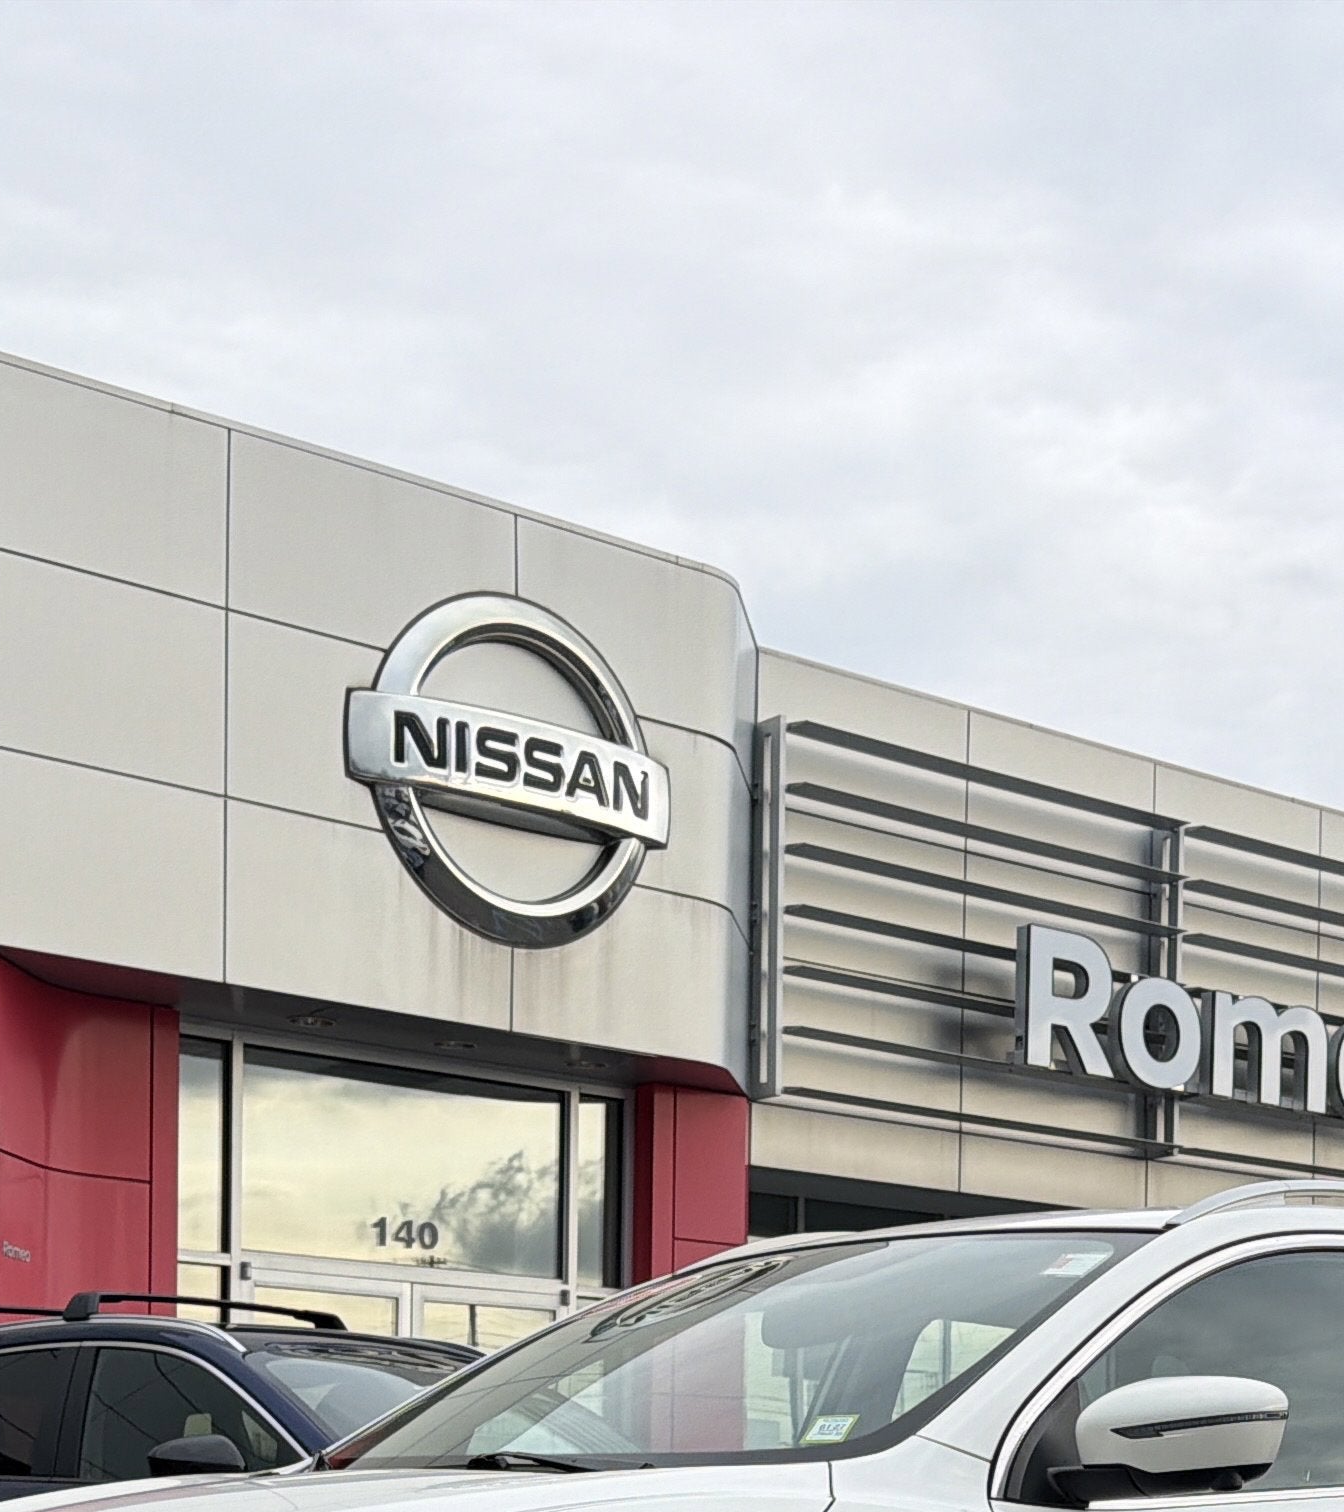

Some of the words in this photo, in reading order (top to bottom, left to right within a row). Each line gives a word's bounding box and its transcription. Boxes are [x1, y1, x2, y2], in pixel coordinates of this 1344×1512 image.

[392, 709, 650, 821] NISSAN
[370, 1216, 439, 1250] 140
[2, 1240, 32, 1263] Romeo
